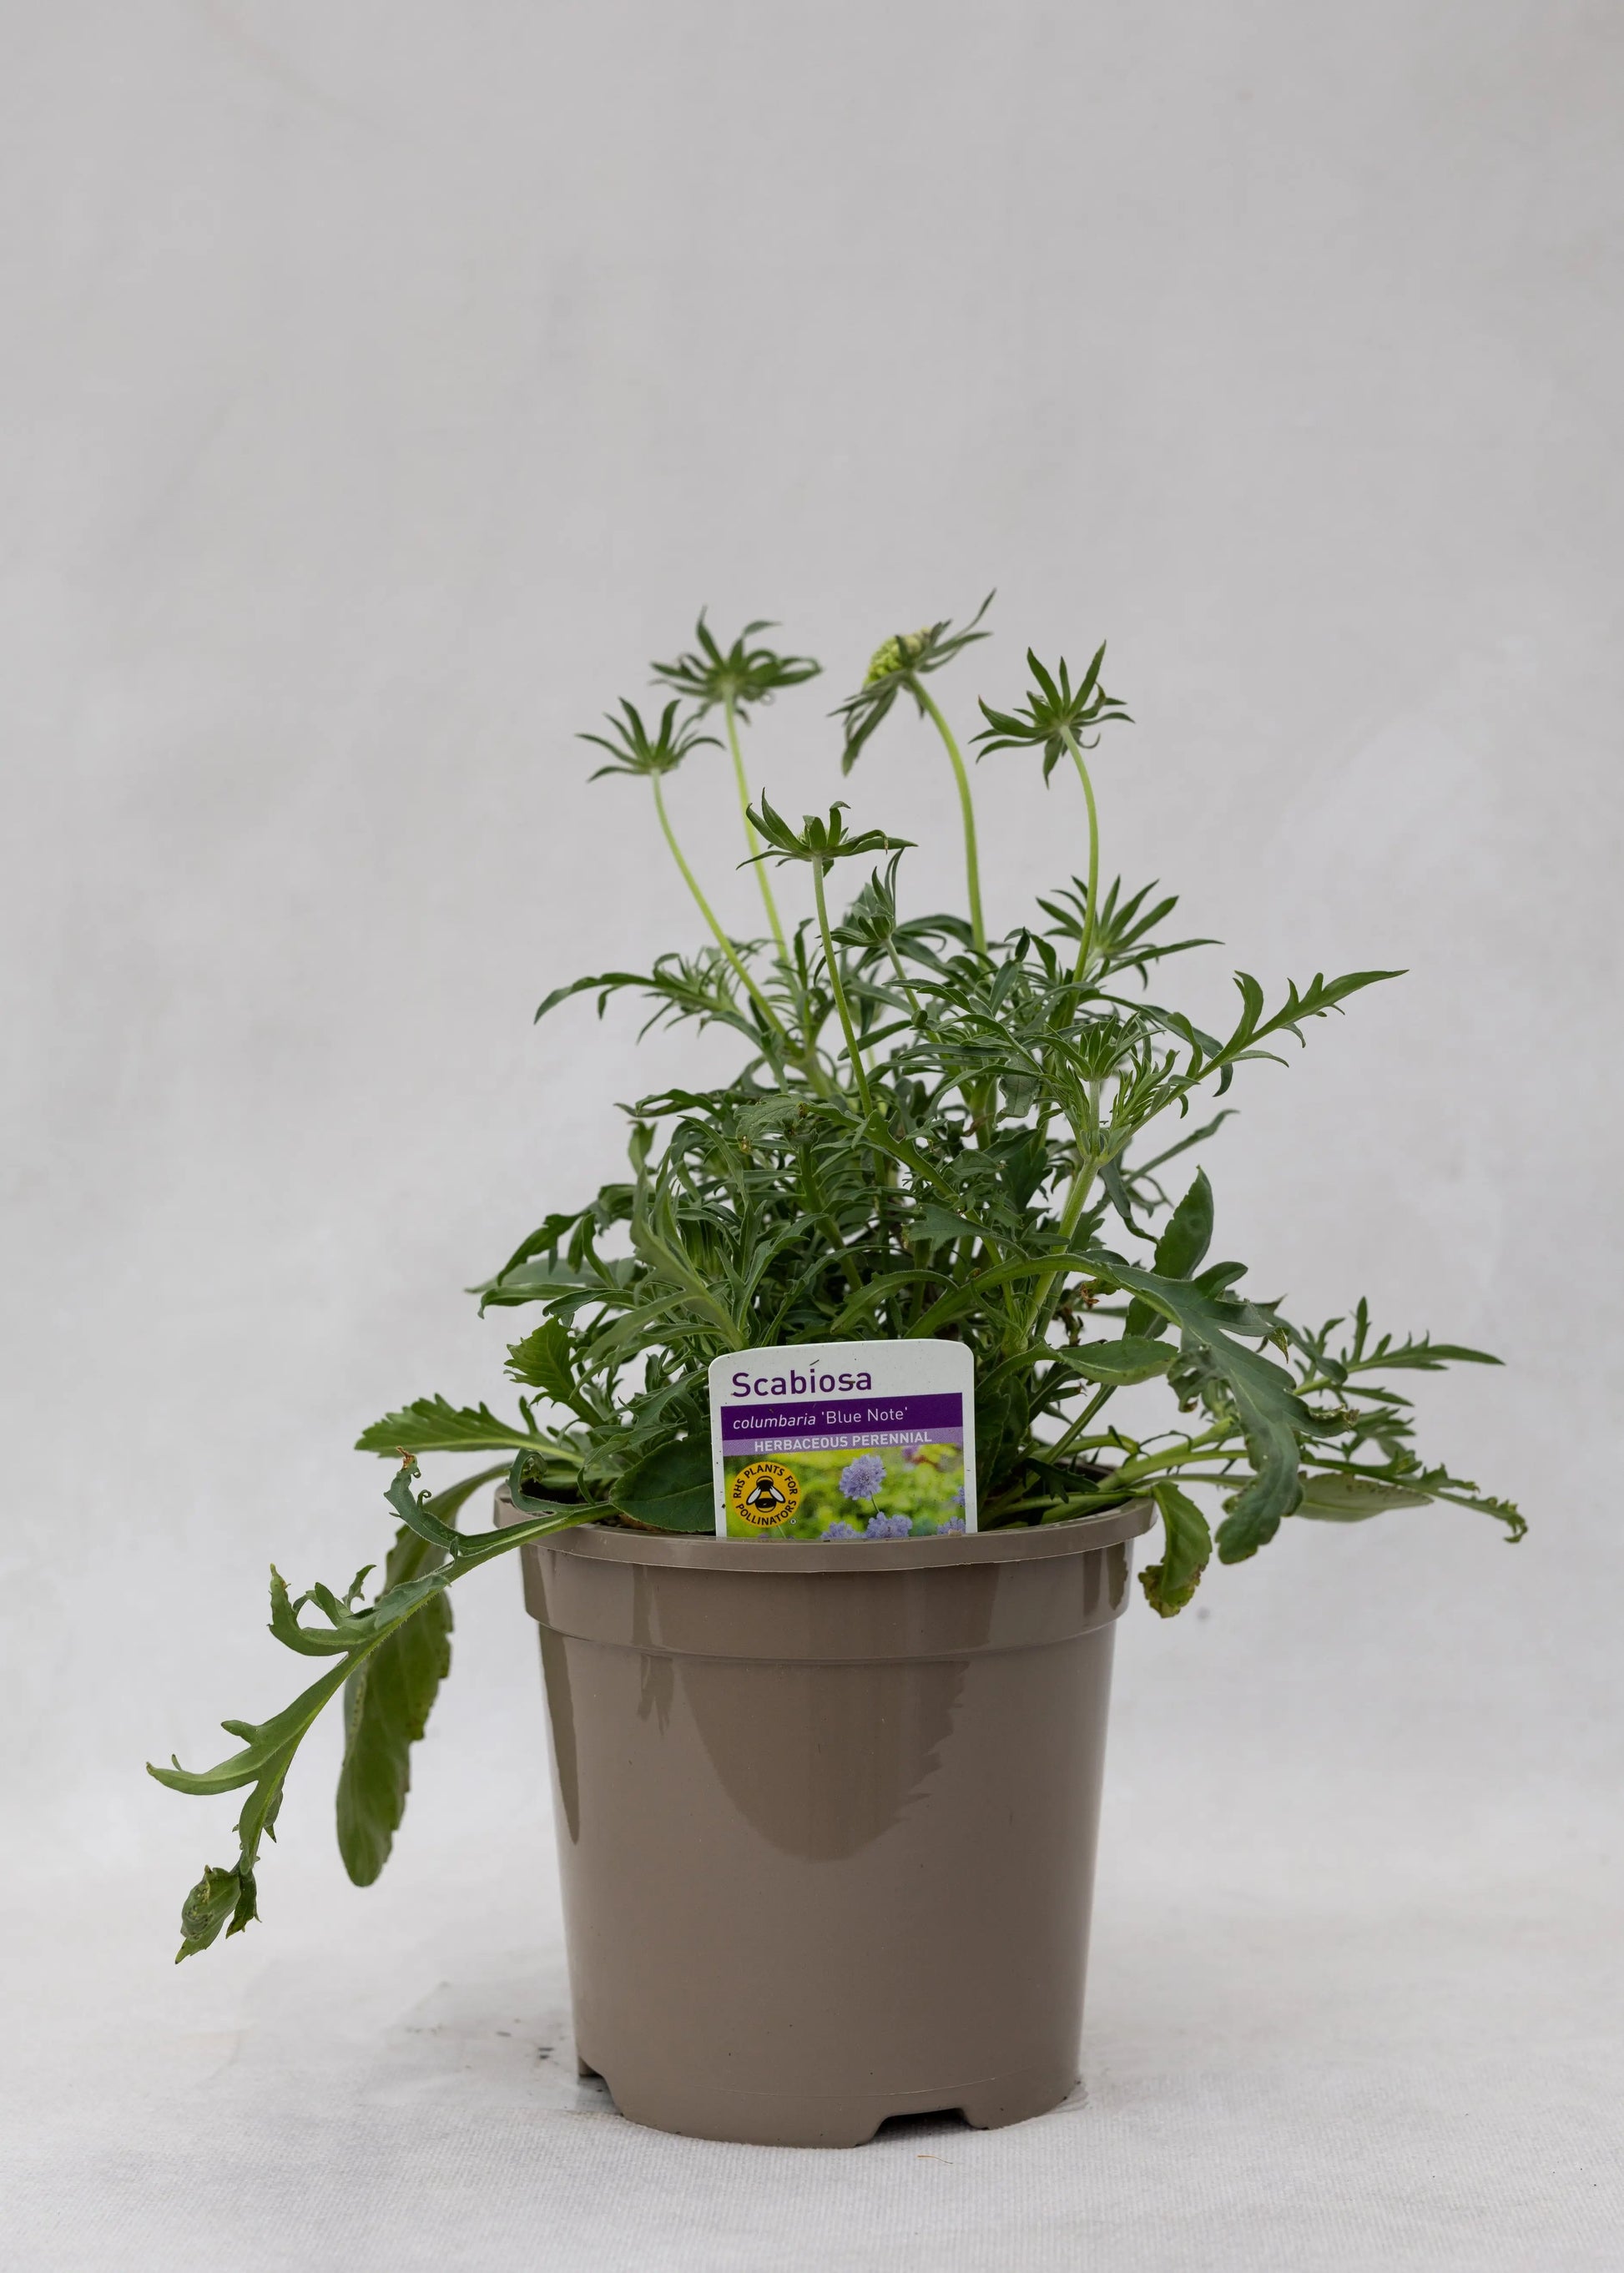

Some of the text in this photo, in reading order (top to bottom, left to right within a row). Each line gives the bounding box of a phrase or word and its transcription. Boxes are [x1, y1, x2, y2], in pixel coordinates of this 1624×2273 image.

[731, 1368, 872, 1398] Scabiosa
[733, 1406, 908, 1429] columbaria 'Blue Note'
[754, 1431, 932, 1452] HERBACEOUS PERENNIAL
[733, 1464, 798, 1499] RHS PLANTS FOR
[735, 1499, 797, 1525] POLLINATORS
